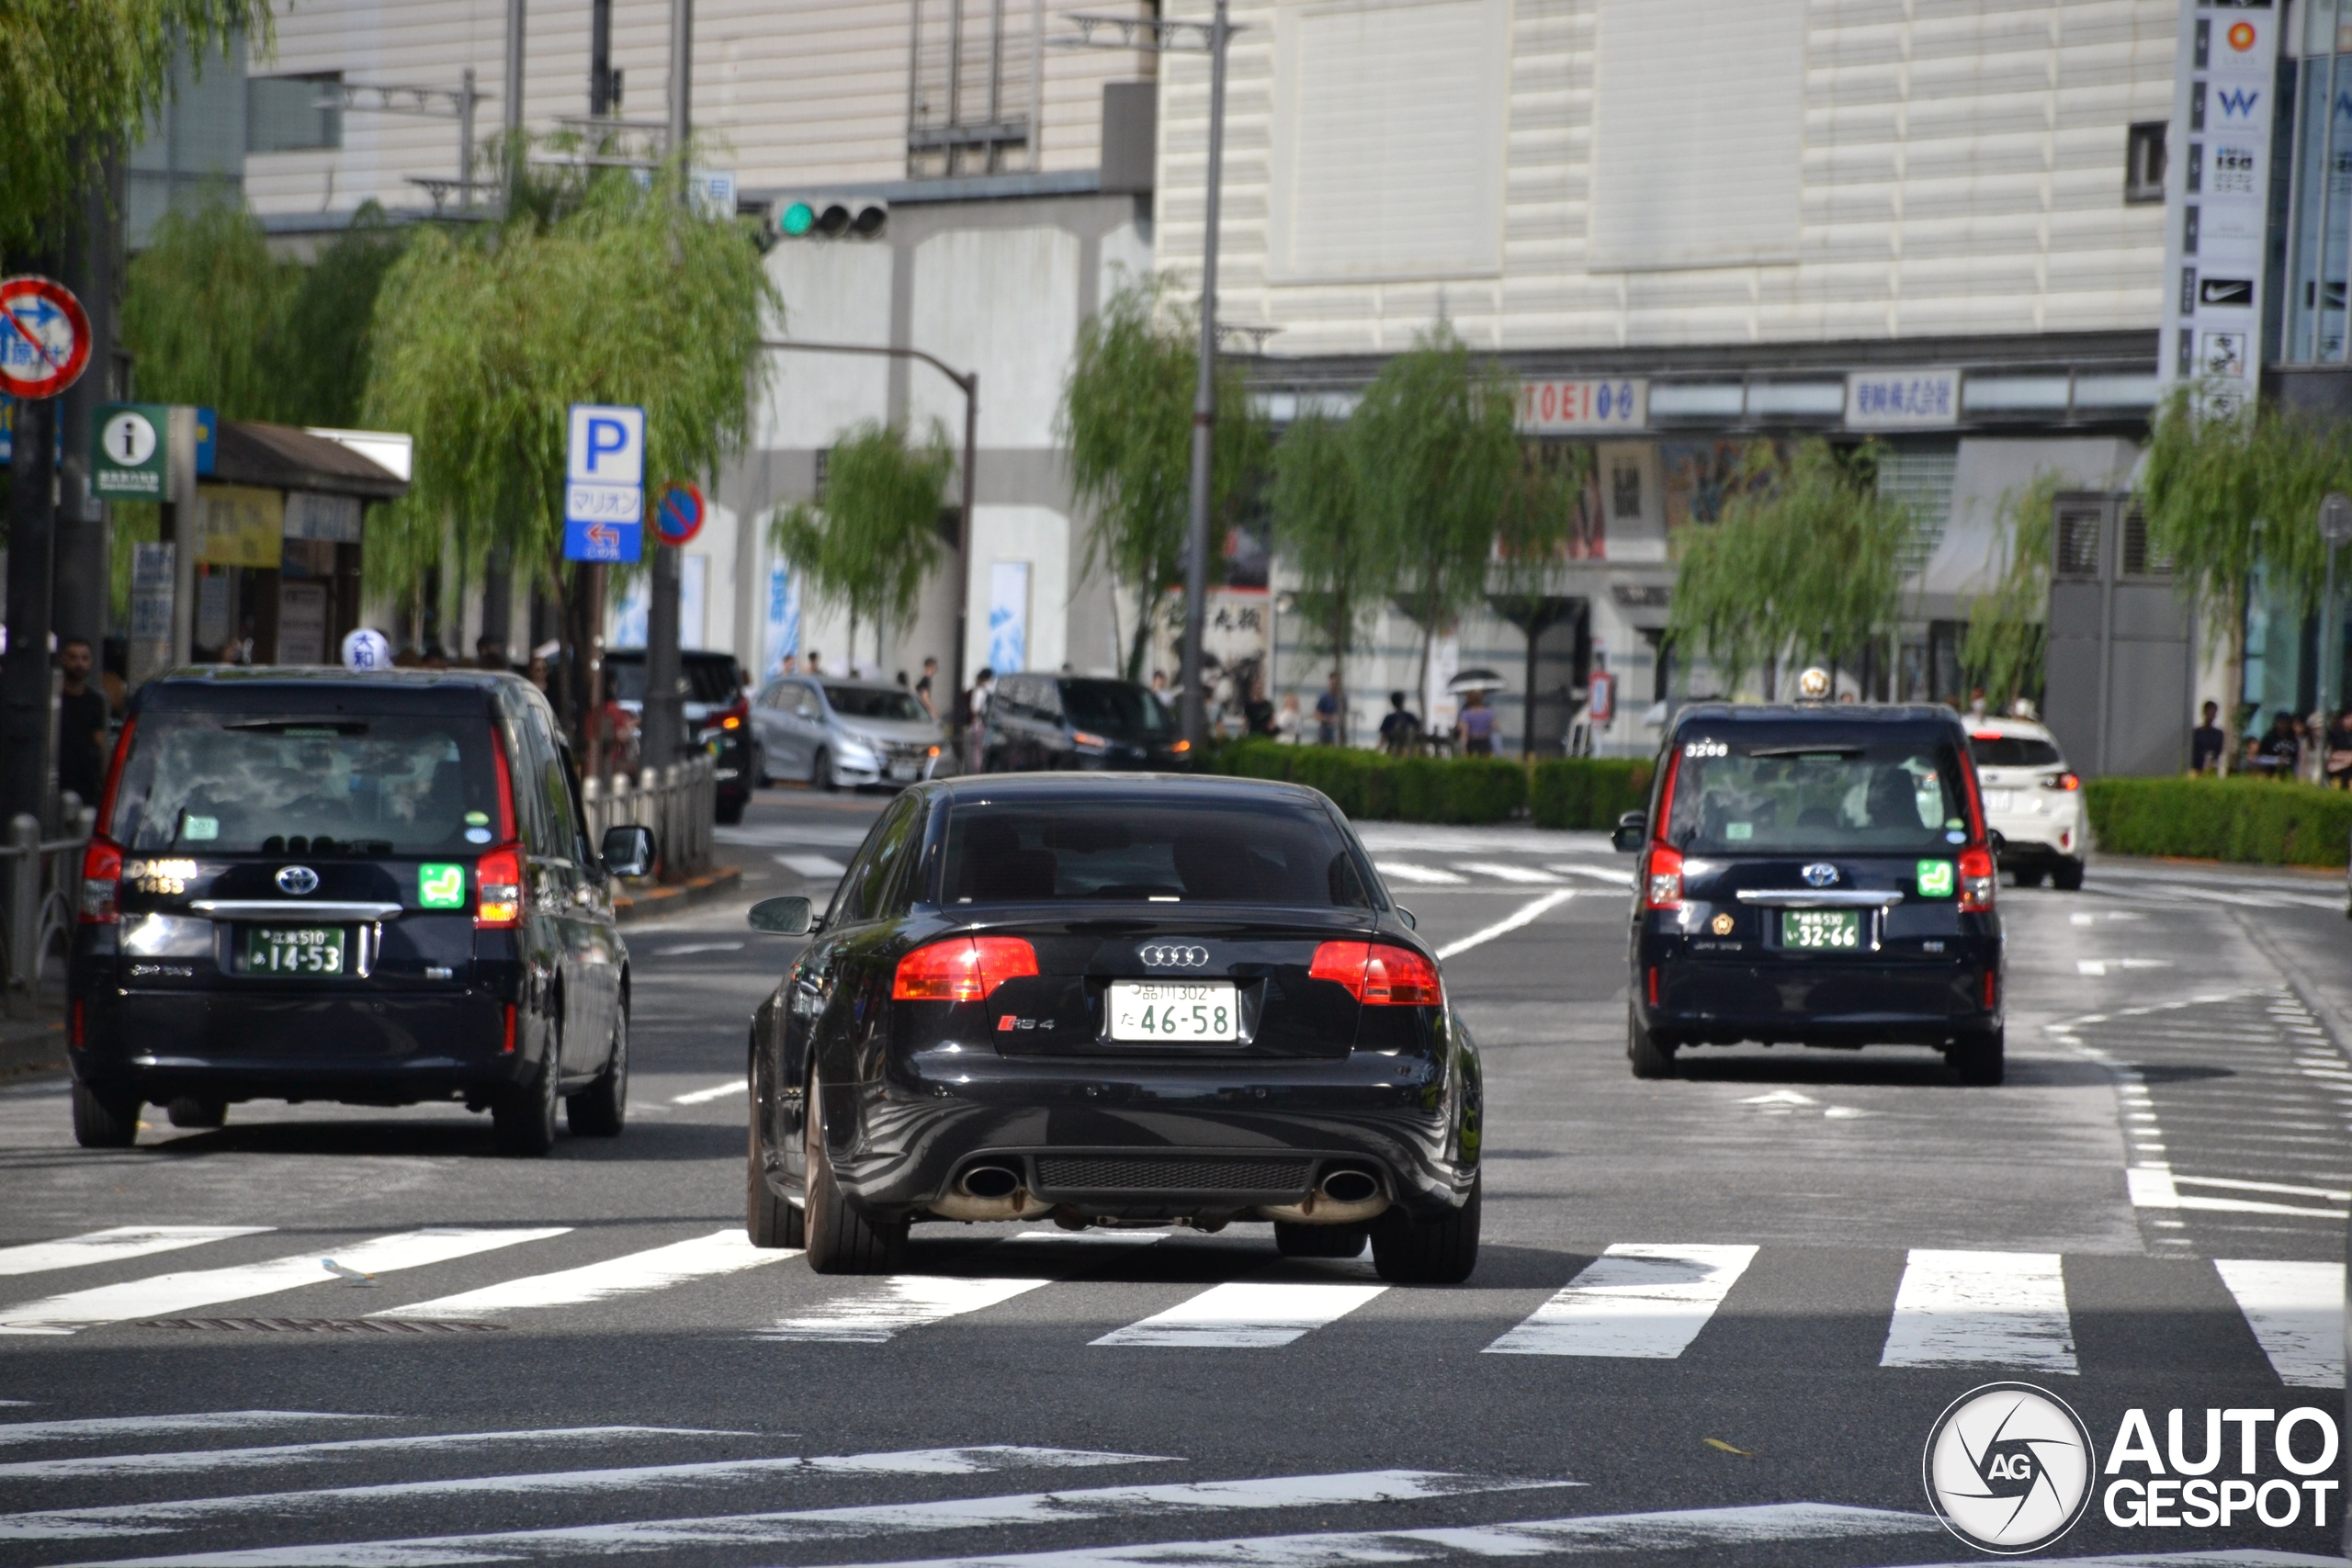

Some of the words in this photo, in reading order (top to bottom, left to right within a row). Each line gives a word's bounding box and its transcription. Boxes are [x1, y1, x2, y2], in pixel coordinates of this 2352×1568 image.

[1523, 382, 1590, 423] TOEI
[586, 418, 629, 471] P
[571, 490, 639, 515] マリオン
[584, 546, 621, 560] この先
[1685, 742, 1729, 758] 3266
[136, 877, 185, 895] 1453
[1799, 925, 1855, 946] 32-66
[270, 945, 339, 971] 14-53
[1121, 1012, 1135, 1026] た
[1141, 1005, 1228, 1034] 46-58
